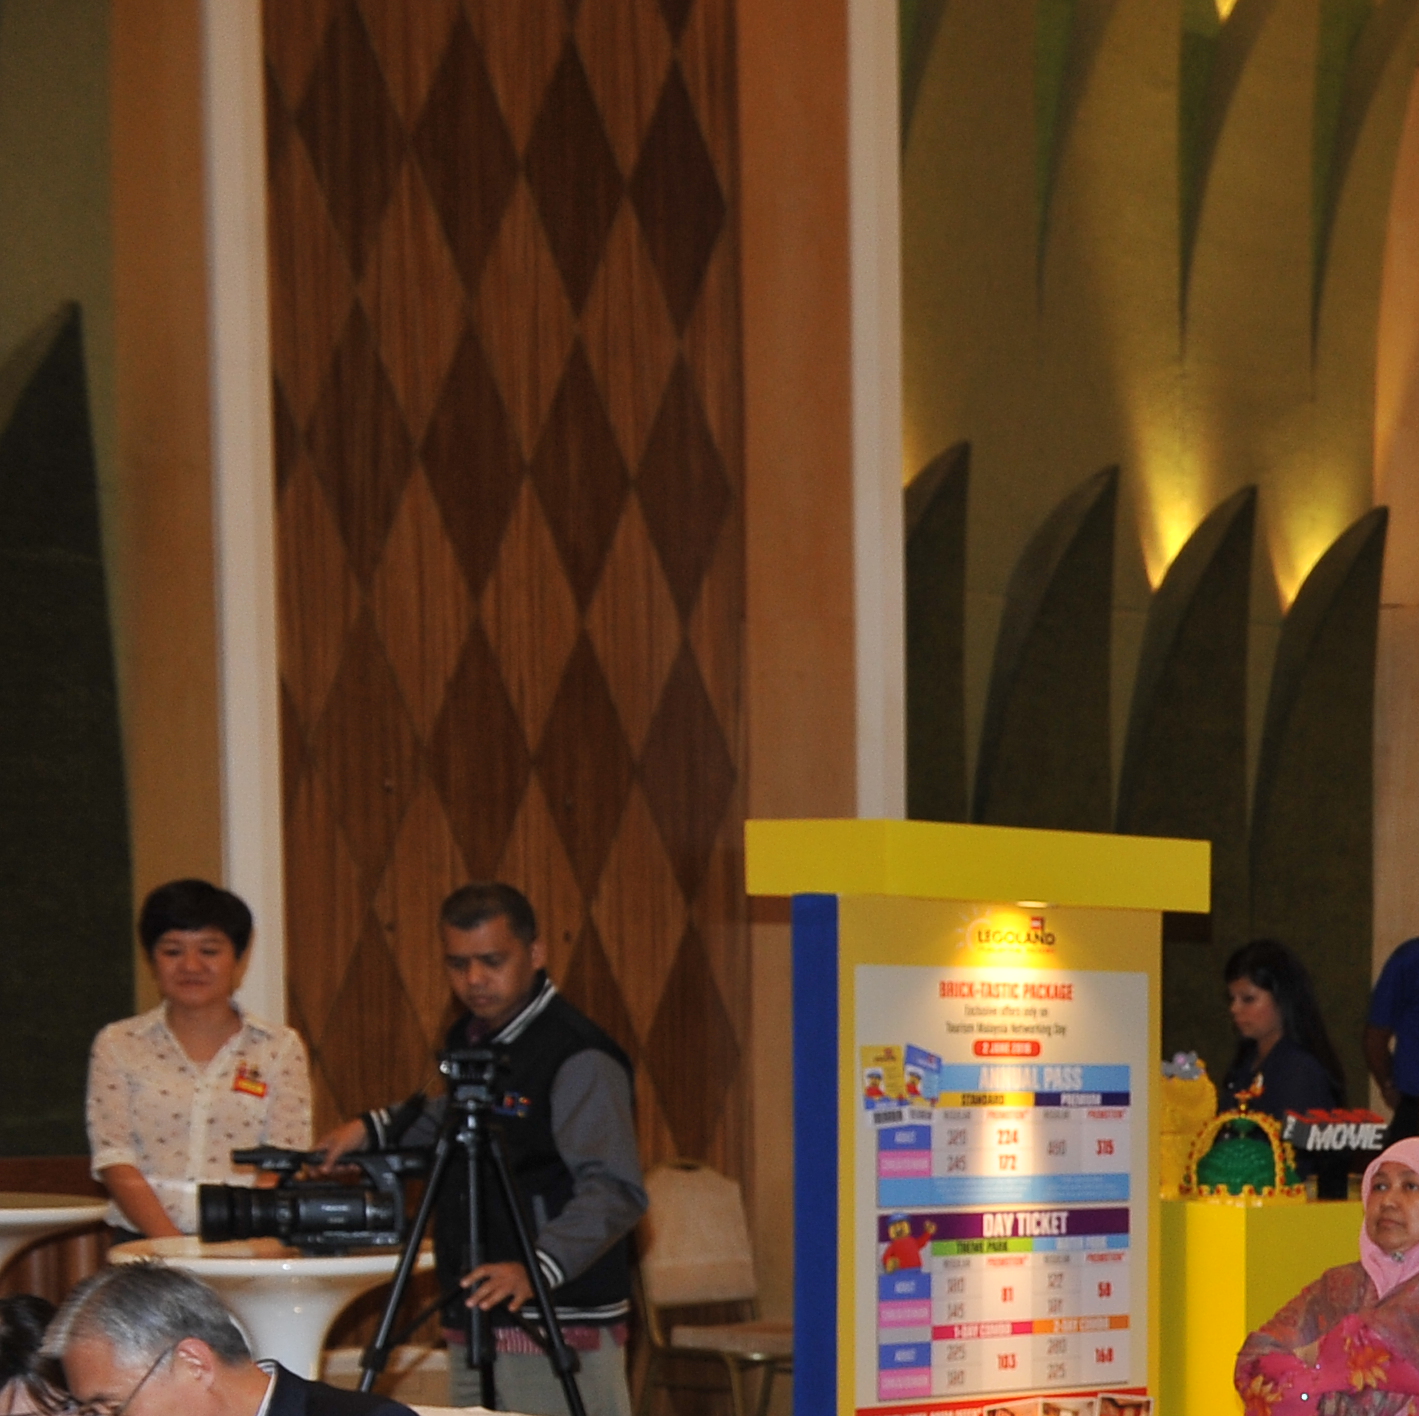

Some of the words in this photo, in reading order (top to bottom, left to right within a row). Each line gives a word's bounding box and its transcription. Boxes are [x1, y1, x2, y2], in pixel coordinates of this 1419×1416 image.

[939, 981, 1018, 1000] BRICK-TASTIC
[1023, 982, 1074, 1001] PACKAGE
[1042, 1066, 1084, 1090] PASS
[997, 1129, 1018, 1145] 224
[1305, 1122, 1389, 1152] MOVIE
[982, 1213, 1014, 1237] DAY
[1015, 1211, 1069, 1236] TICKET
